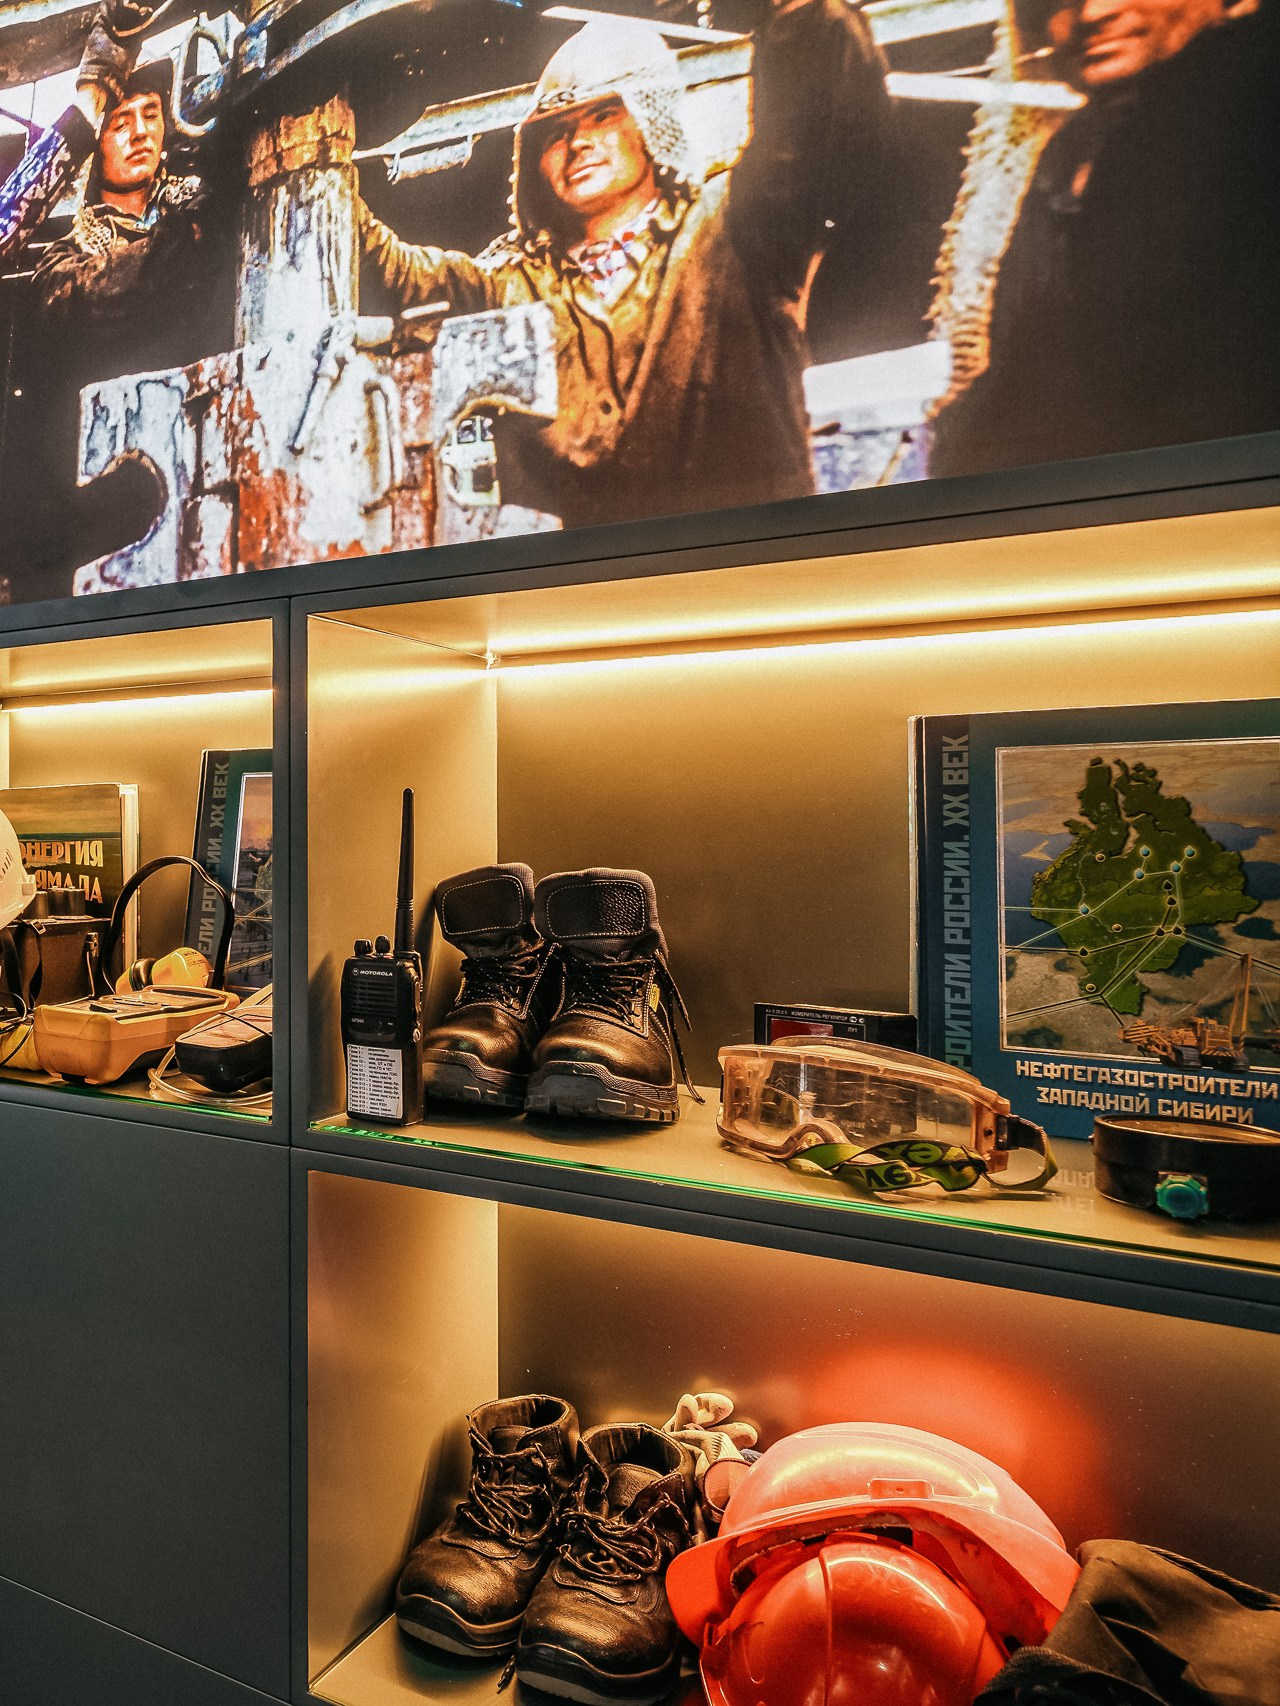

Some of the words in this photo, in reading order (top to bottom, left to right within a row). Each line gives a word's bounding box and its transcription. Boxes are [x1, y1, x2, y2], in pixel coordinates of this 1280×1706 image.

[942, 734, 969, 785] ВЕК
[212, 762, 230, 799] ВЕК
[943, 834, 970, 944] РОССИИ.
[1016, 1060, 1278, 1099] НЕФТЕГАЗОСТРОИТЕЛИ
[1036, 1086, 1150, 1114] ЗАПАДНОЙ
[1158, 1098, 1254, 1125] СИБИРИ
